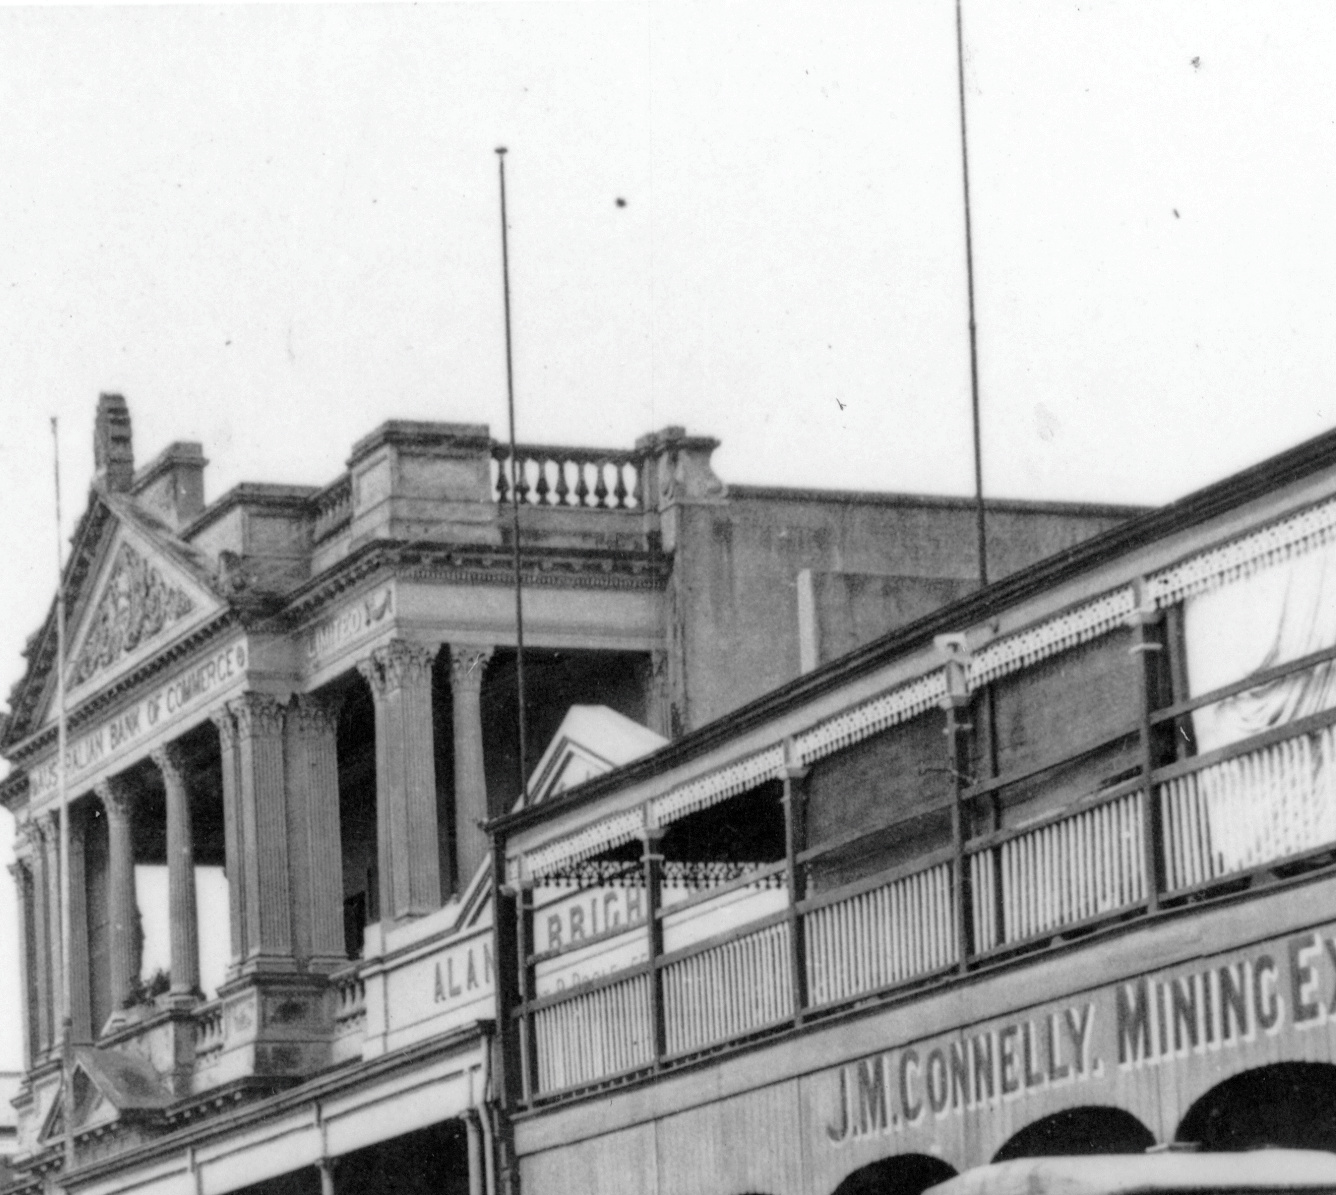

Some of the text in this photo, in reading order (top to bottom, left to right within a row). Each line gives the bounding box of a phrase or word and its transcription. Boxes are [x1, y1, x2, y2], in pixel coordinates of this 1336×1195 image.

[110, 706, 141, 750] BANK
[147, 692, 162, 725] OF
[166, 647, 235, 714] COMMERCE
[1116, 954, 1281, 1066] MINING
